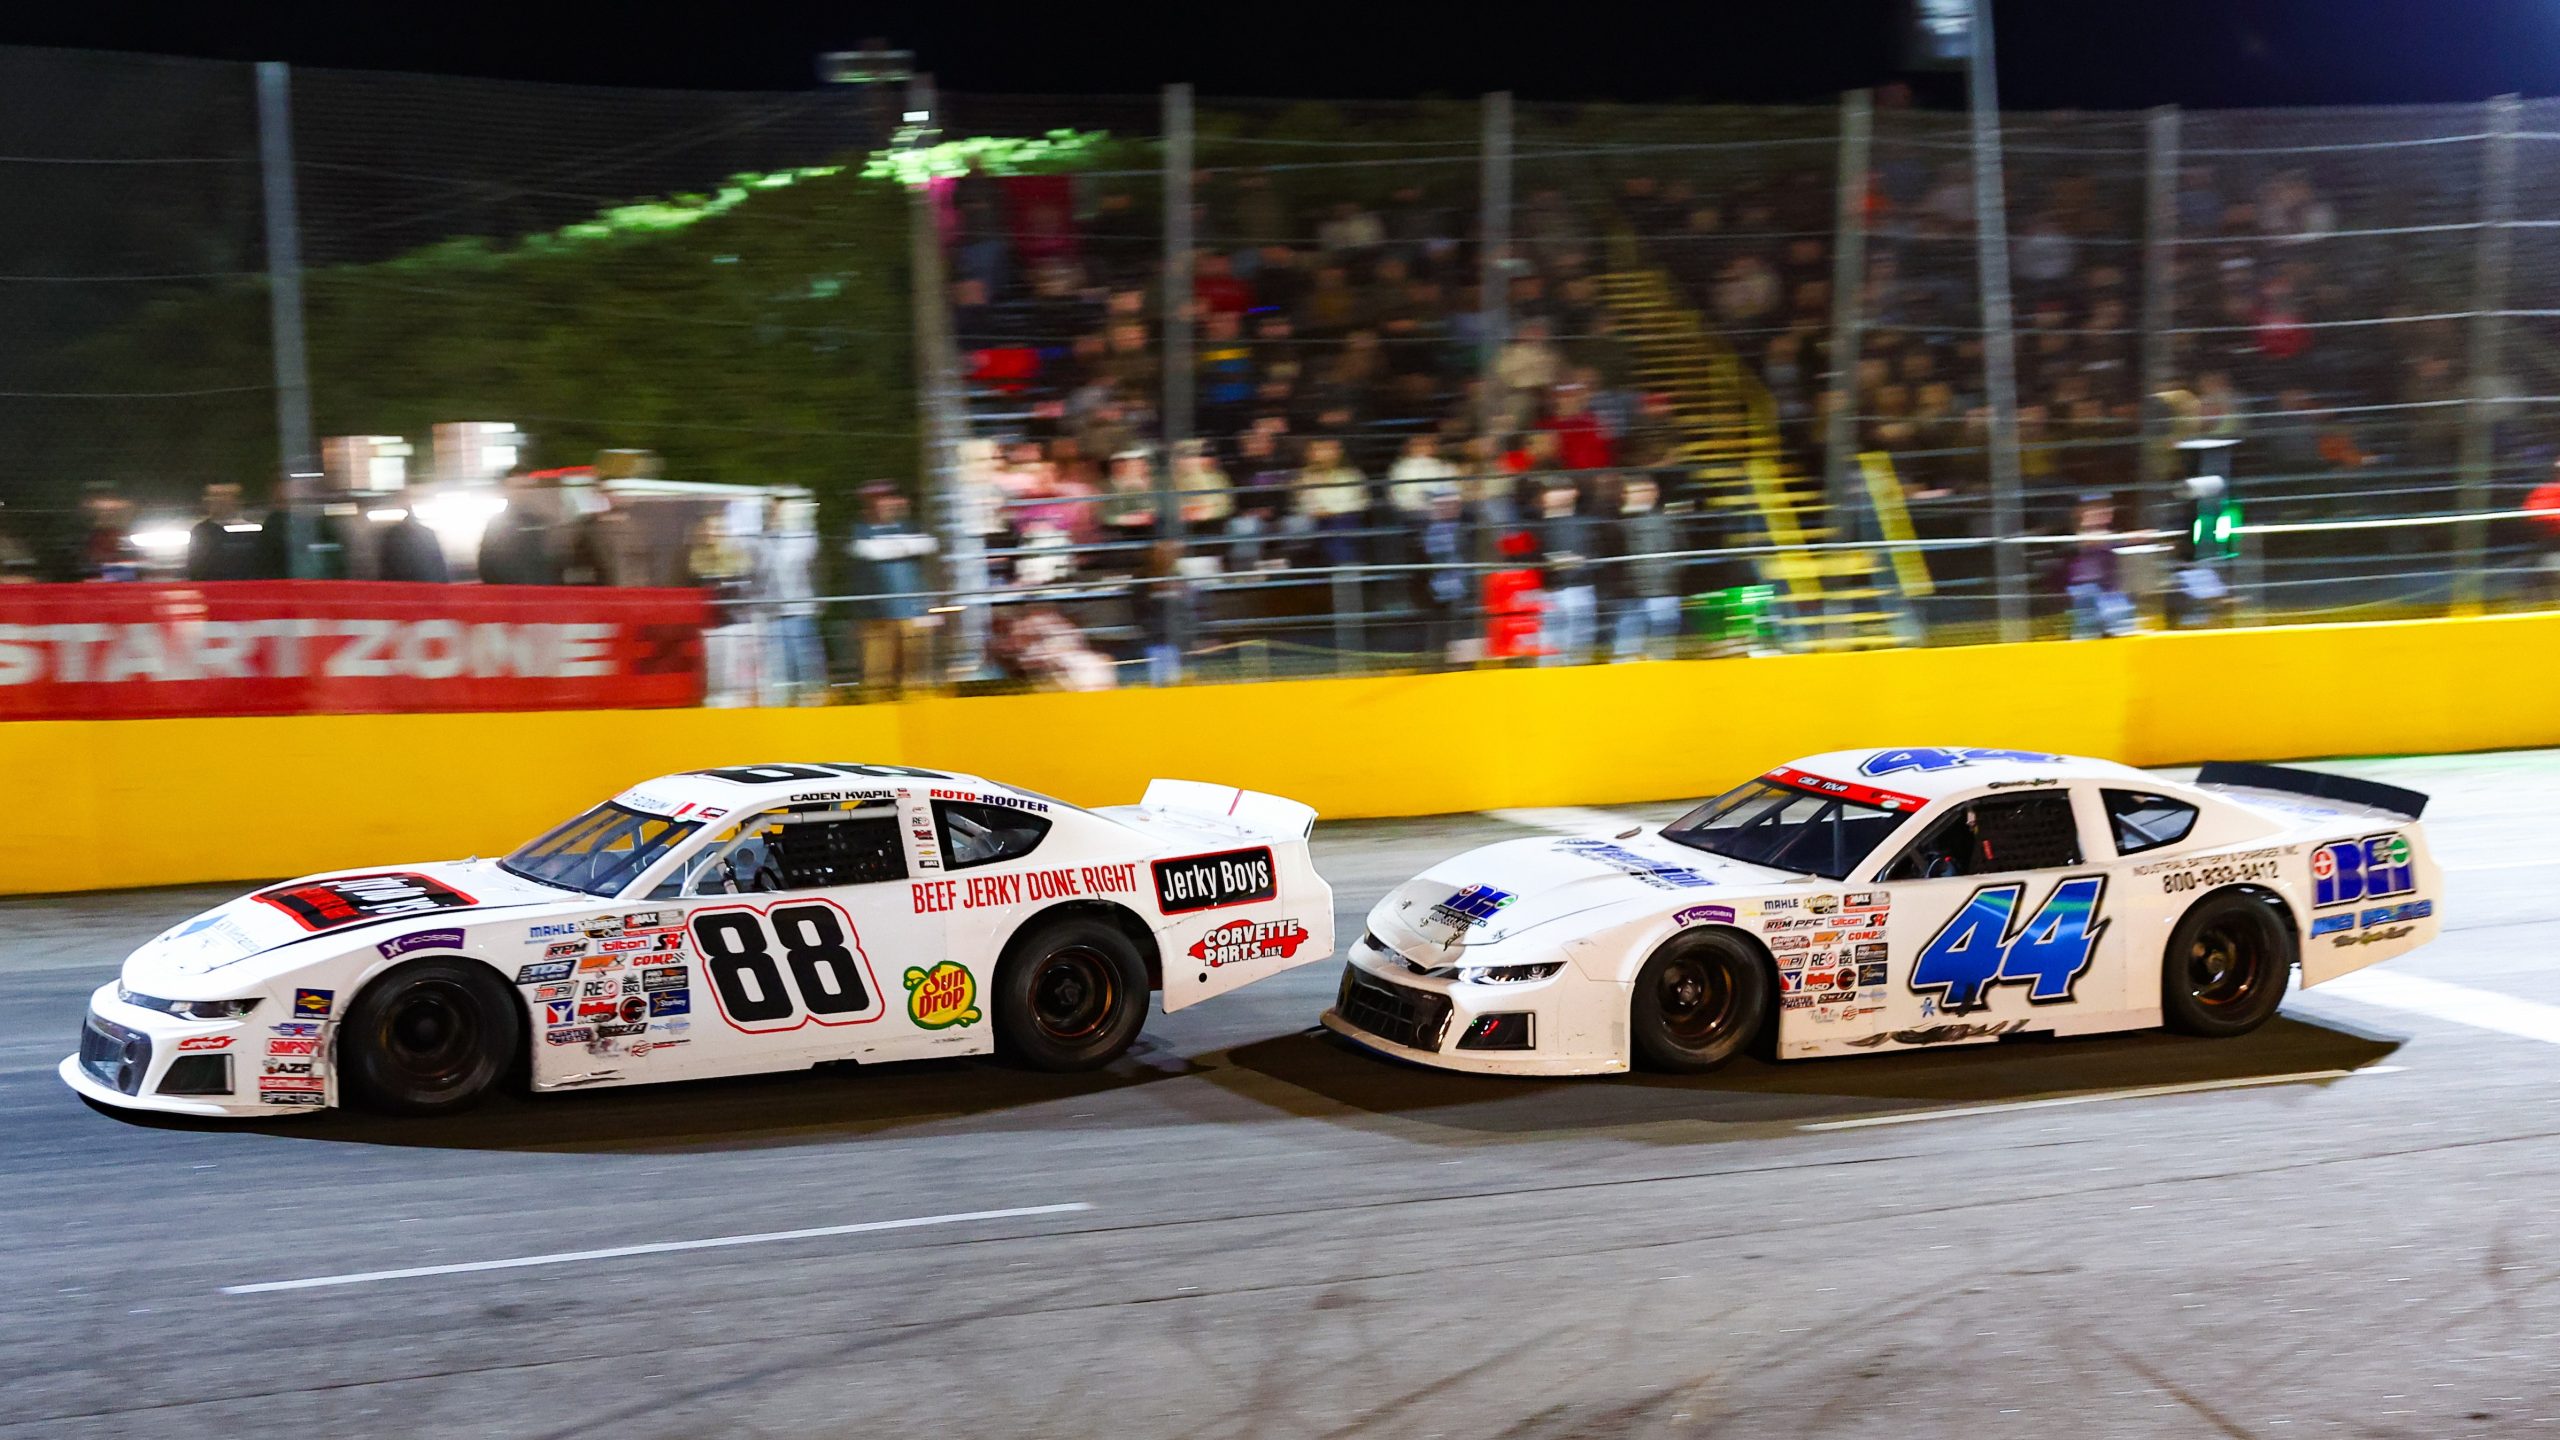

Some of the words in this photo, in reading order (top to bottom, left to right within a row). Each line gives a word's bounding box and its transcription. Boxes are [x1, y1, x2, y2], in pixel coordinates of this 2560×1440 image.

[790, 791, 841, 802] CADEN
[845, 790, 894, 800] KVAPIL
[930, 789, 1048, 813] ROTO-ROOTER
[912, 881, 957, 914] BEEF
[963, 874, 1021, 909] JERKY
[1025, 868, 1081, 901] DONE
[1081, 864, 1137, 894] RIGHT
[1164, 864, 1217, 902] Jerky
[1220, 860, 1269, 893] Boys
[1764, 898, 1799, 910] MAHLE
[529, 923, 575, 938] MAHLE
[1203, 918, 1298, 948] CORVETTE
[1848, 931, 1878, 941] COMP
[1907, 873, 2112, 1017] 44
[633, 953, 674, 966] COMP
[693, 904, 870, 1023] 88
[923, 967, 965, 996] Sun
[919, 986, 965, 1019] Drop
